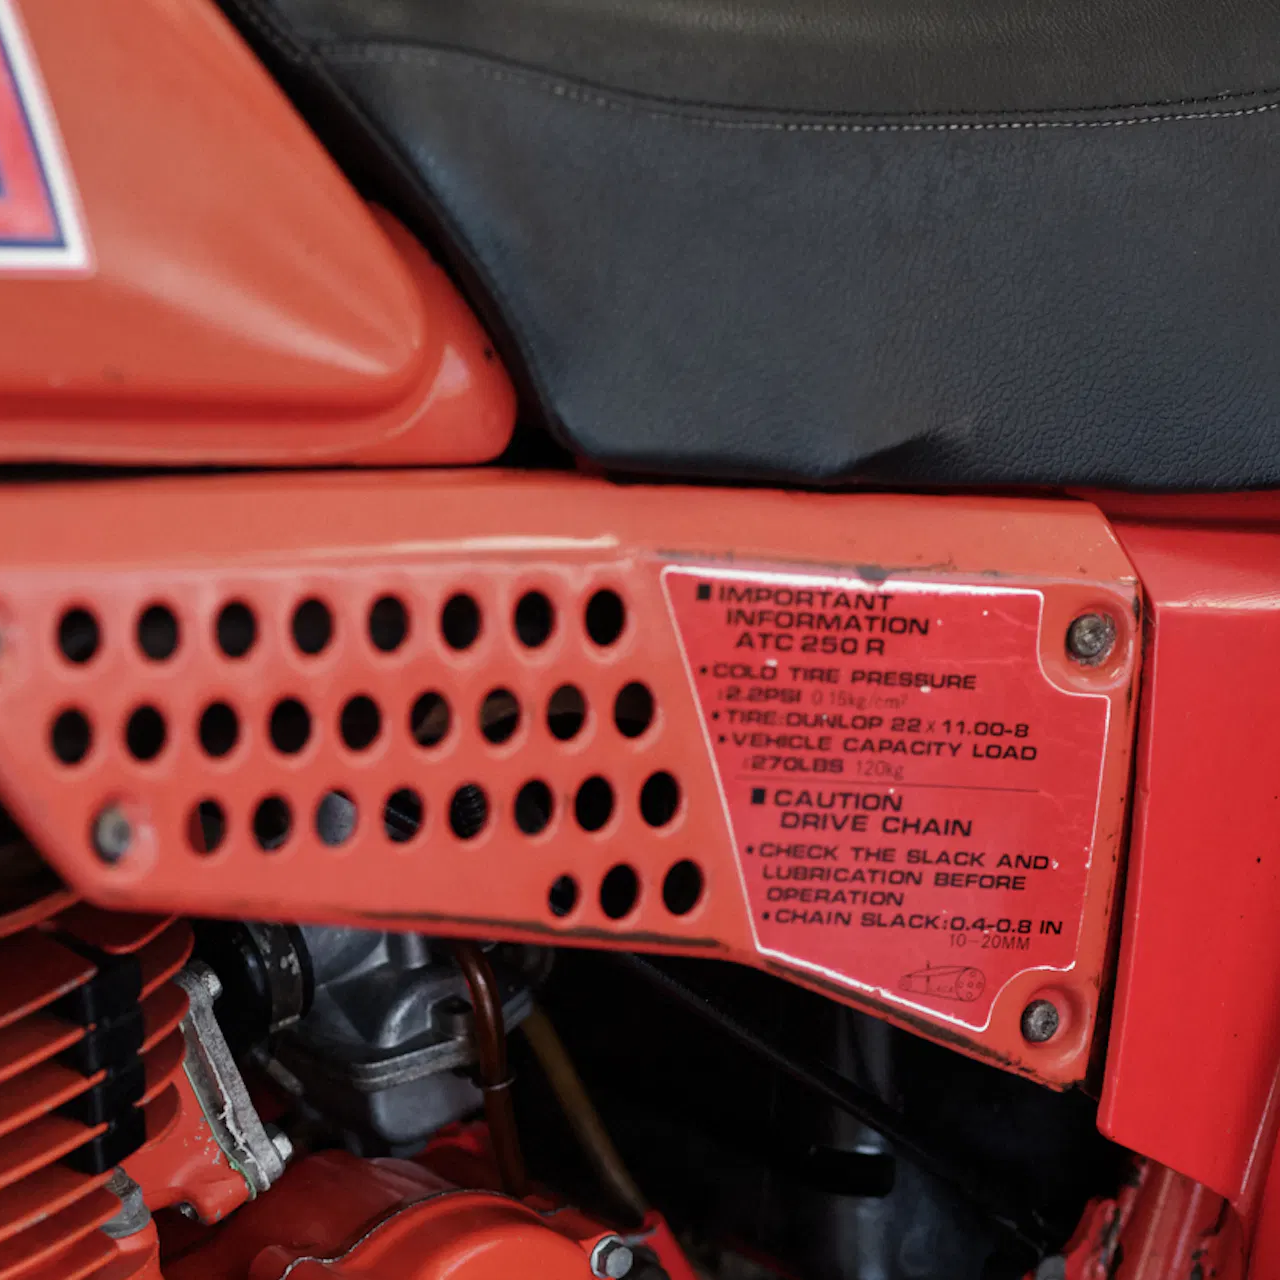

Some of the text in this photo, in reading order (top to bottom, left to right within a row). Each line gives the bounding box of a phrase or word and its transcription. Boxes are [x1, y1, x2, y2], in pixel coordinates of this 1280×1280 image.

[721, 585, 894, 612] IMPORTANT
[726, 608, 929, 635] INFORMATION
[736, 631, 885, 656] ATC 250 R
[712, 662, 977, 690] COLD TIRE PRESSURE
[732, 732, 1037, 762] VEHICLE CAPACITY LOAD
[773, 789, 903, 812] CAUTION
[780, 812, 973, 837] DRIVE CHAIN
[759, 843, 1050, 870] CHECK THE SLACK AND
[762, 865, 1027, 891] LUBRICATION BEFORE
[767, 887, 904, 907] OPERATION
[775, 909, 852, 927] CHAIN
[1039, 918, 1064, 936] IN
